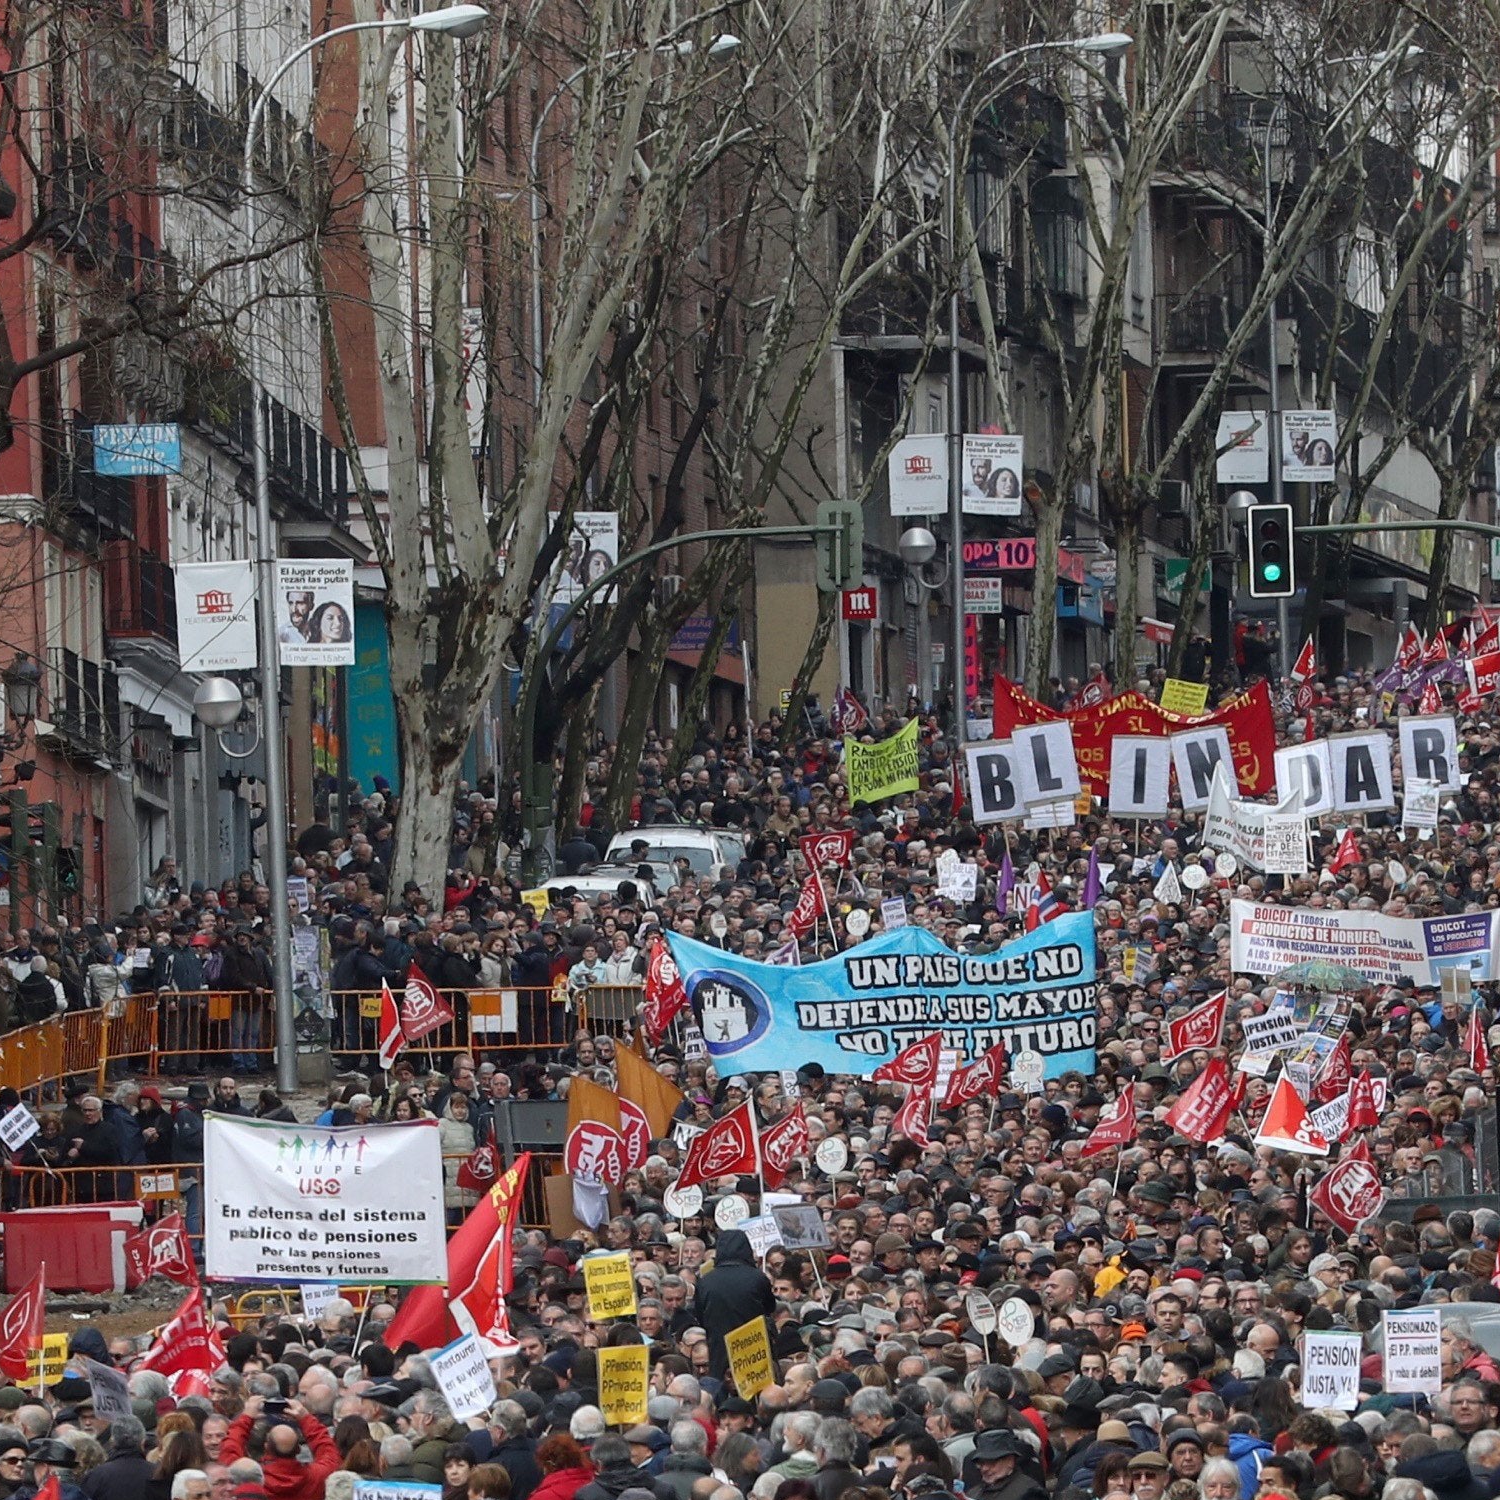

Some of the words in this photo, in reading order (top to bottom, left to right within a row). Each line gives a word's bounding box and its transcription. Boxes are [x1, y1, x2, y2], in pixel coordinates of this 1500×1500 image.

[1004, 541, 1030, 566] 10
[280, 576, 306, 584] rezan
[307, 575, 322, 584] las
[323, 575, 350, 586] putas
[291, 568, 315, 579] lugar
[317, 567, 347, 576] donde
[1030, 733, 1063, 792] L
[1412, 728, 1449, 785] R
[1132, 747, 1147, 804] I
[1185, 738, 1221, 799] N
[1344, 744, 1382, 804] A
[976, 753, 1016, 813] B
[1254, 907, 1293, 922] BOICOT
[1293, 914, 1299, 924] A
[1300, 915, 1324, 927] TODOS
[1325, 917, 1340, 928] LOS
[1430, 920, 1467, 934] BOICOT
[1251, 920, 1313, 941] PRODUCTOS
[1315, 928, 1329, 942] DE
[1431, 934, 1446, 943] LOS
[1446, 928, 1487, 941] PRODUCTOS
[1249, 936, 1274, 947] HASTA
[1276, 940, 1290, 950] QUE
[1340, 945, 1357, 955] SUS
[1255, 949, 1270, 960] LOS
[846, 956, 899, 990] UN
[903, 953, 961, 986] PAÍS
[964, 957, 1029, 986] QUE
[1033, 943, 1083, 976] NO
[408, 983, 432, 1015] UGT
[797, 1002, 930, 1030] DEFIENDE
[945, 996, 992, 1023] SUS
[298, 1177, 342, 1196] USO
[221, 1204, 241, 1219] En
[247, 1205, 313, 1221] defensa
[318, 1208, 346, 1222] del
[353, 1207, 427, 1222] sistema
[229, 1226, 292, 1242] público
[297, 1227, 319, 1241] de
[324, 1229, 419, 1246] pensiones
[261, 1245, 283, 1257] Por
[288, 1246, 307, 1258] las
[311, 1248, 382, 1261] pensiones
[255, 1262, 323, 1275] presentes
[325, 1264, 334, 1276] y
[337, 1263, 390, 1275] futuras
[1387, 1321, 1438, 1334] PENSIONAZO:
[1306, 1341, 1358, 1370] ¡PENSIÓN
[1413, 1343, 1438, 1356] miente
[1306, 1375, 1338, 1395] JUSTA,
